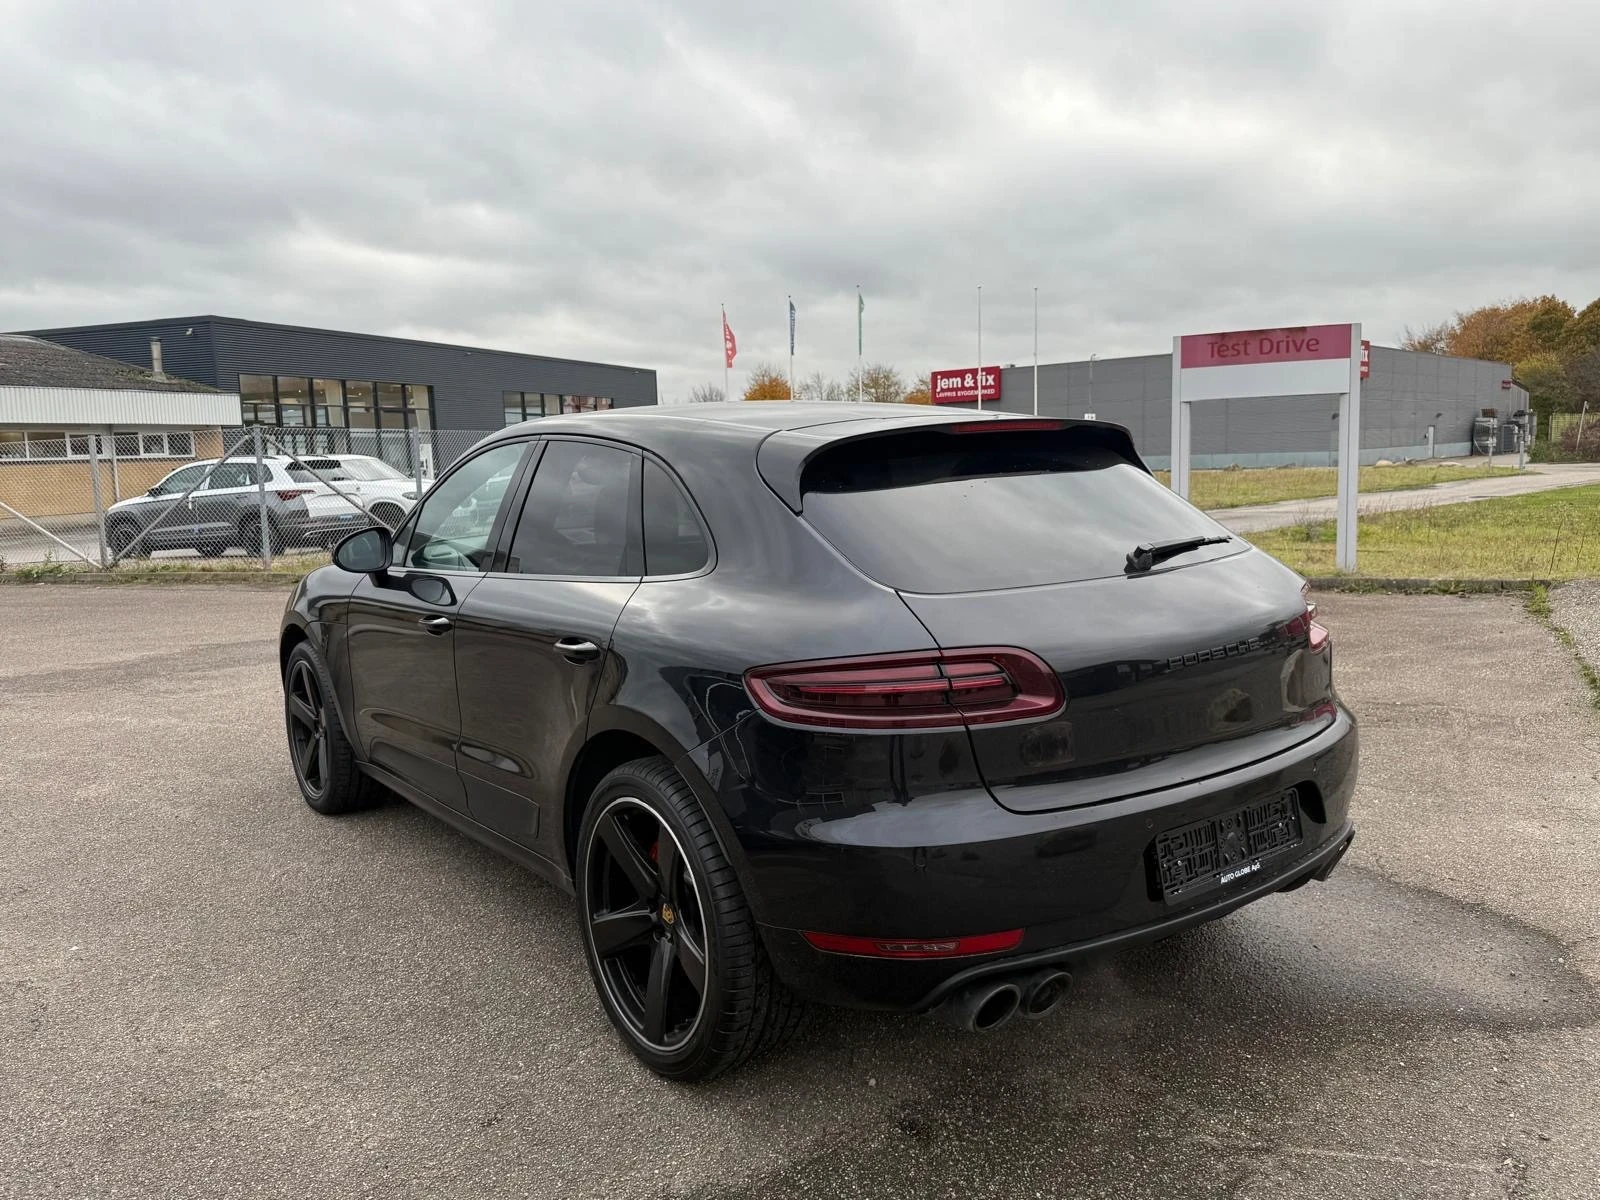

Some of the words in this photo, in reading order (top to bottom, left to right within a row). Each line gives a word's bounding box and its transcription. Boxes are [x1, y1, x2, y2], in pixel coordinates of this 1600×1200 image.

[1207, 340, 1250, 358] Test
[1259, 335, 1320, 355] Drive
[936, 375, 961, 392] jem
[964, 373, 974, 387] &
[957, 388, 995, 397] BYGGEMRKED
[1168, 637, 1260, 671] PORSCHE
[1221, 873, 1234, 884] AUTO
[1234, 866, 1250, 877] GLOBE
